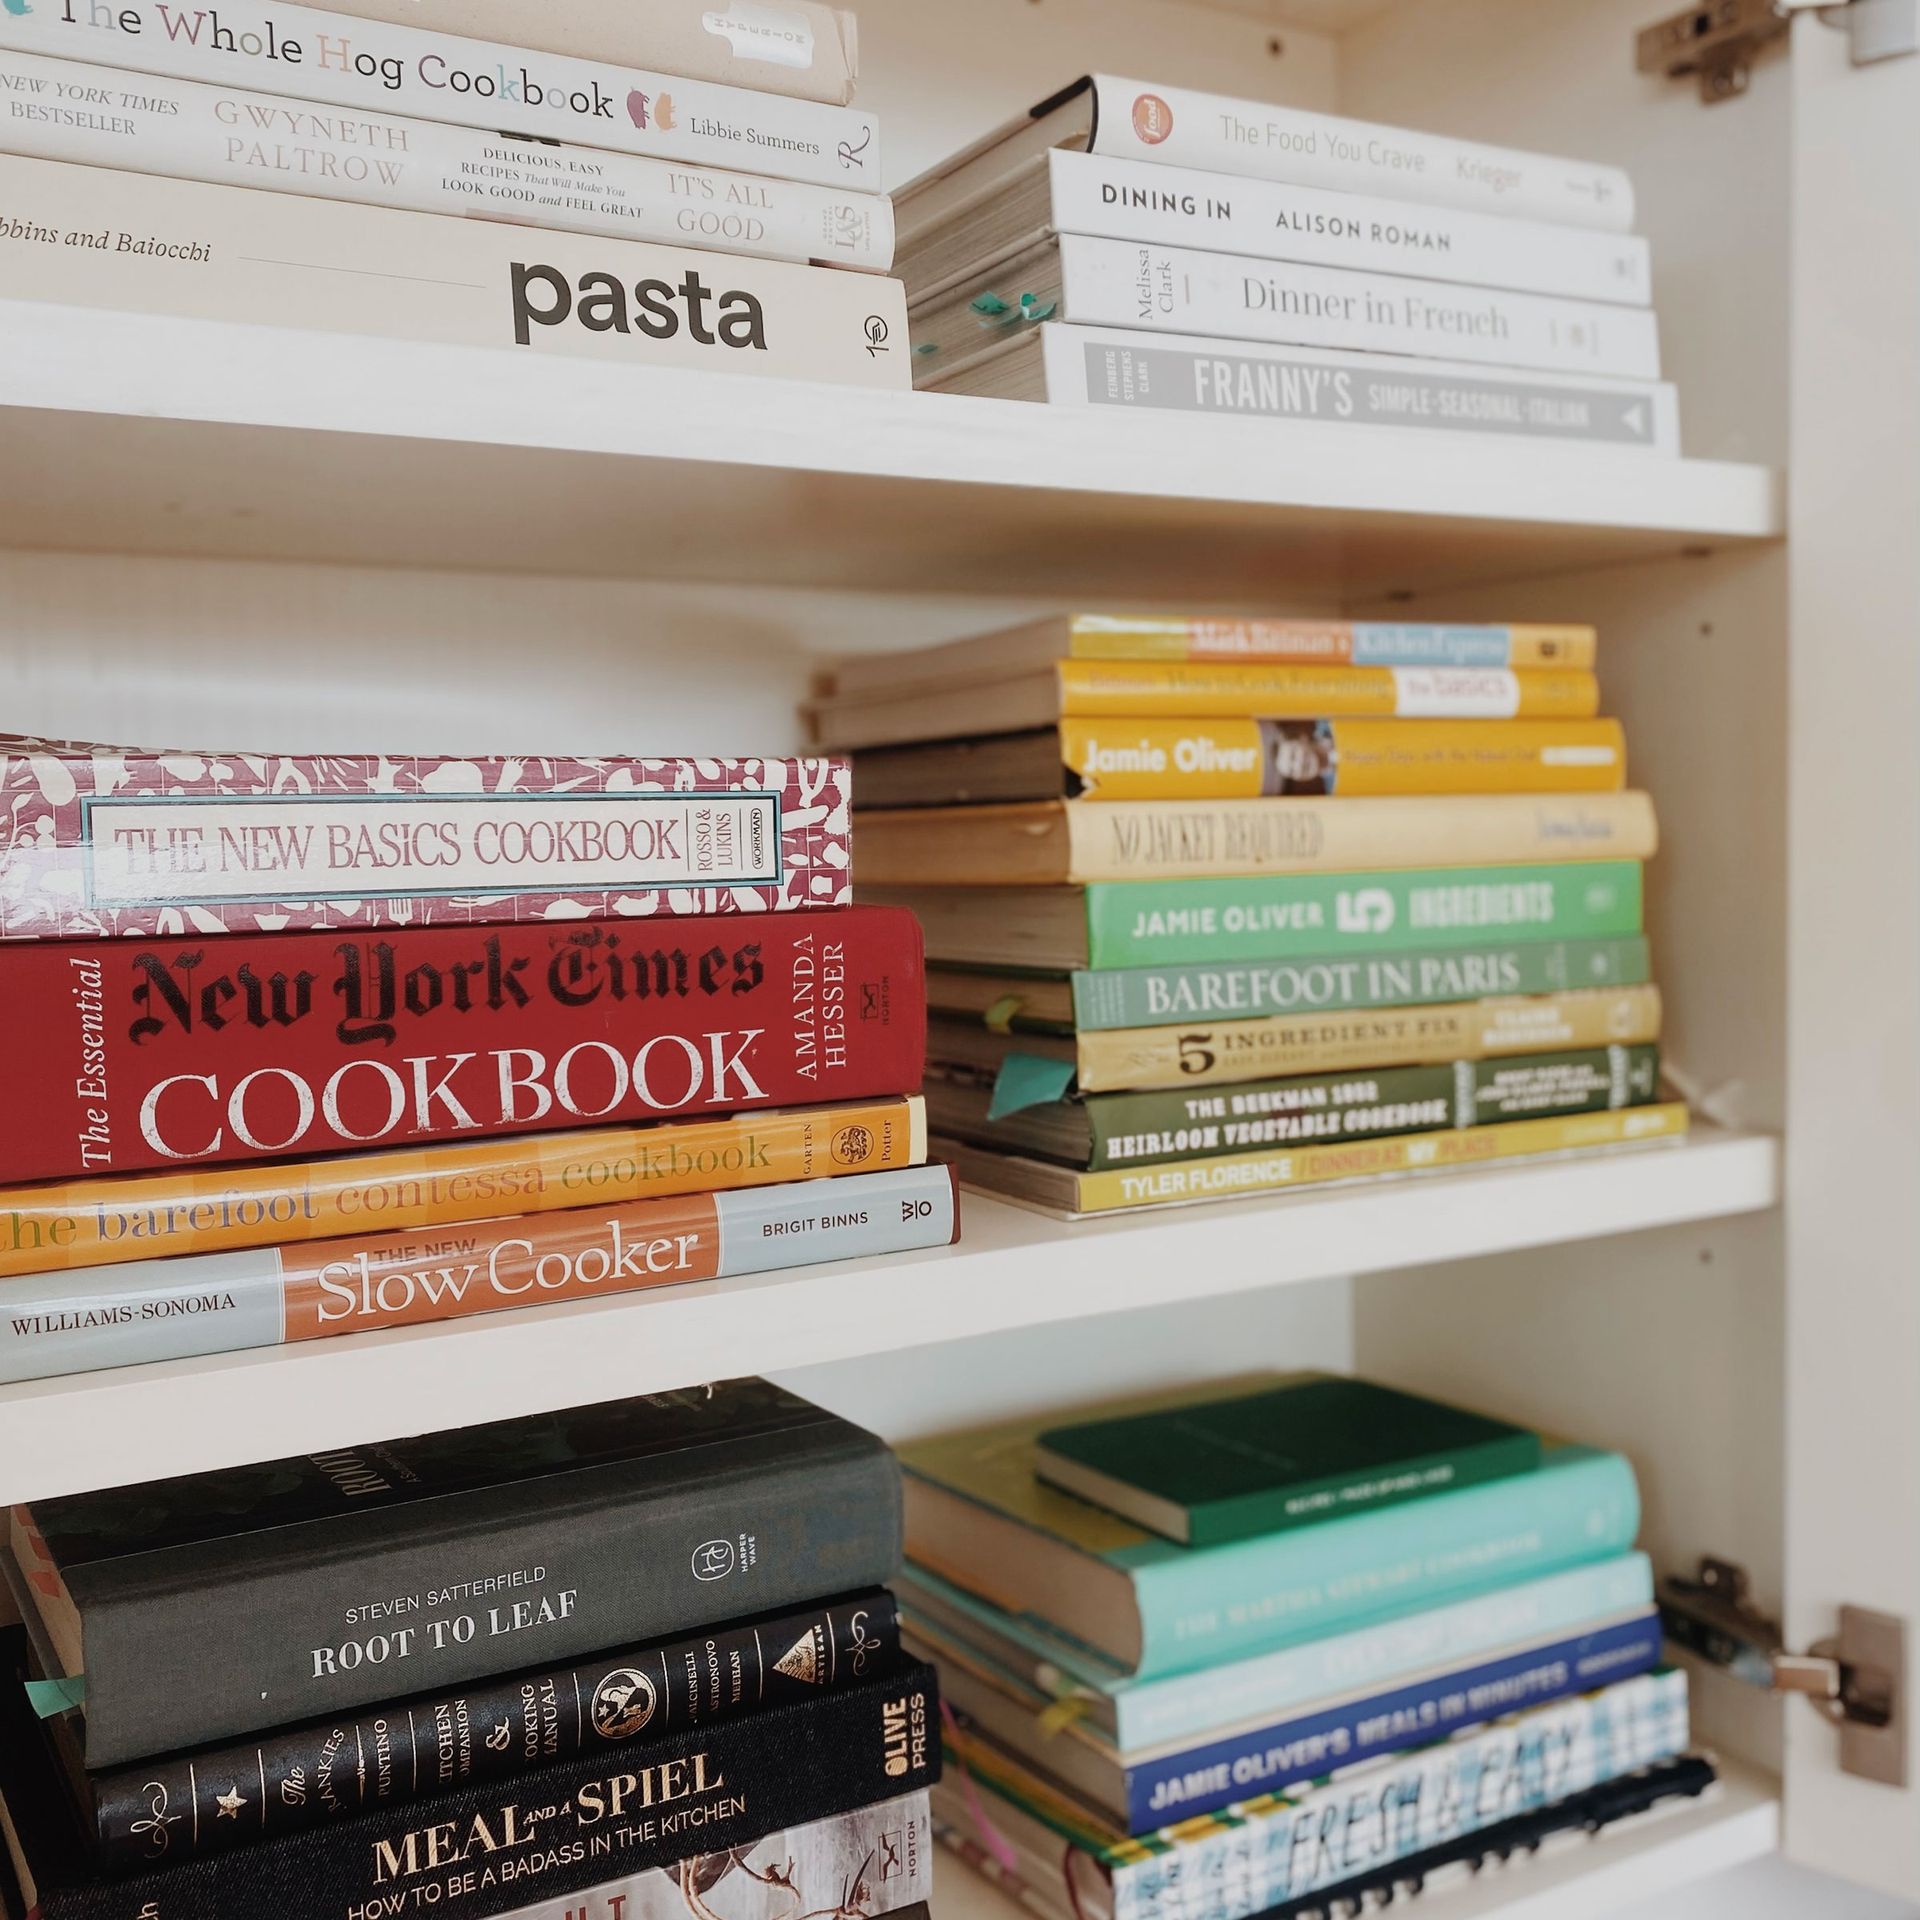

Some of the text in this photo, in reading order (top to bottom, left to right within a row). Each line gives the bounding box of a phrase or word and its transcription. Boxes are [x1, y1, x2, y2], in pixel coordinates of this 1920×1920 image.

[0, 73, 179, 116] NEW YORK TIMES
[155, 4, 821, 155] Whole Hog Cookbook Libbie Summers
[11, 101, 136, 135] BESTSELLER
[213, 100, 410, 152] GWYNETH
[1144, 98, 1161, 137] food
[1219, 114, 1259, 145] The
[1266, 124, 1317, 155] Food
[1323, 132, 1361, 162] You
[1367, 140, 1425, 172] Crave
[224, 136, 405, 186] PALTROW
[460, 161, 627, 198] RECIPES That Will Make You
[483, 147, 605, 176] DELICIOUS, EASY
[441, 177, 644, 219] LOOK GOOD and FEEL GREAT
[667, 172, 774, 209] IT'S ALL
[1101, 183, 1452, 251] DINING IN ALISON ROMAN
[64, 230, 109, 251] and
[115, 232, 212, 263] Baiocchi
[676, 208, 764, 241] GOOD
[509, 261, 769, 352] pasta
[1135, 248, 1153, 320] Melissa
[1156, 260, 1174, 314] Clark
[1243, 277, 1510, 340] Dinner in French
[1138, 361, 1150, 394] CLARK
[1193, 358, 1354, 418] FRANNY'S
[1083, 735, 1258, 774] Jamie Oliver
[113, 818, 681, 875] THE NEW BASICS COOKBOOK
[695, 807, 713, 871] ROSSO &
[715, 812, 733, 867] LUKINS
[752, 811, 763, 867] WORKMAN
[1111, 810, 1325, 866] NO JACKET REQUIRED
[1131, 880, 1555, 939] JAMIE OLIVER 5 INGREDIENTS
[127, 926, 766, 1048] New York Times
[792, 932, 818, 1082] AMANDA
[822, 941, 847, 1068] HESSER
[881, 974, 890, 1027] NORTON
[1146, 963, 1360, 1014] BAREFOOT
[1367, 959, 1413, 1001] IN
[1418, 952, 1521, 997] PARIS
[68, 955, 113, 1169] The Essential
[1177, 1033, 1216, 1075] 5
[1223, 1018, 1408, 1050] INGREDIENT
[1416, 1014, 1461, 1035] FIX
[138, 1028, 770, 1161] COOKBOOK
[1184, 1097, 1227, 1120] THE
[802, 1122, 812, 1175] GARTEN
[881, 1118, 892, 1162] Potter
[1106, 1099, 1449, 1160] HEIRLOOM VEGETABLE COOKBOOK
[96, 1187, 320, 1242] barefoot
[334, 1166, 549, 1216] contessa
[560, 1134, 772, 1190] cookbook
[1120, 1169, 1188, 1200] TYLER
[1189, 1158, 1293, 1192] FLORENCE
[373, 1238, 478, 1264] THE NEW
[762, 1211, 869, 1238] BRIGIT BINNS
[317, 1219, 700, 1324] Slow Cooker
[11, 1292, 236, 1337] WILLIAMS-SONOMA
[738, 1531, 749, 1573] HARPER
[747, 1534, 757, 1559] WAVE
[345, 1566, 546, 1625] STEVEN SATTERFIELD
[310, 1588, 579, 1679] ROOT TO LEAF
[815, 1623, 825, 1685] ARTISAN
[485, 1715, 511, 1751] &
[882, 1697, 909, 1778] OLIVE
[911, 1692, 928, 1769] PRESS
[1148, 1659, 1569, 1811] JAMIE OLIVER'S MEALS IN MINUTES
[281, 1765, 306, 1806] The
[371, 1752, 725, 1886] MEAL AND A SPIEL
[348, 1794, 747, 1920] HOW TO BE A BADASS IN THE KITCHEN
[907, 1819, 918, 1878] NORTON
